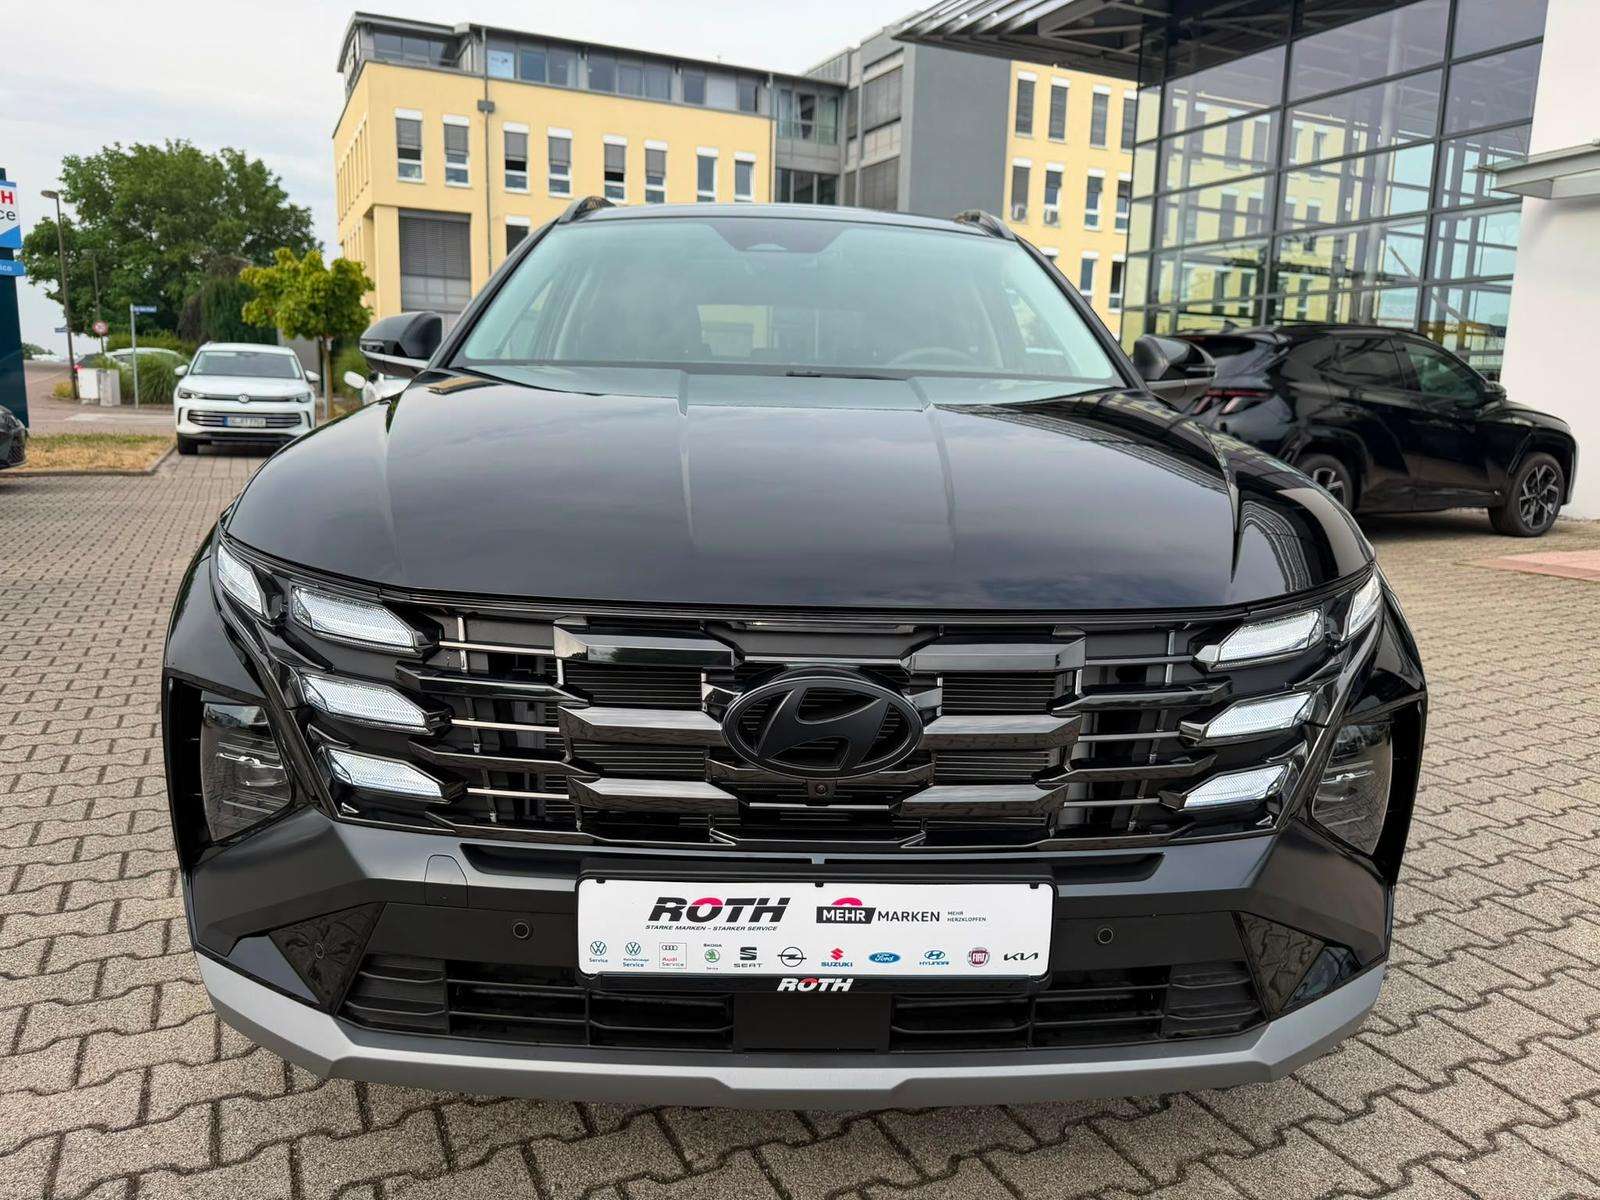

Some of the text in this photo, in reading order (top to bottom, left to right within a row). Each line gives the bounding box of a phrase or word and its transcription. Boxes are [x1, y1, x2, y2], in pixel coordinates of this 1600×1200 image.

[648, 896, 791, 923] ROTH
[822, 909, 940, 922] MEHR MARKEN
[874, 953, 894, 962] Ford
[776, 977, 854, 992] ROTH
